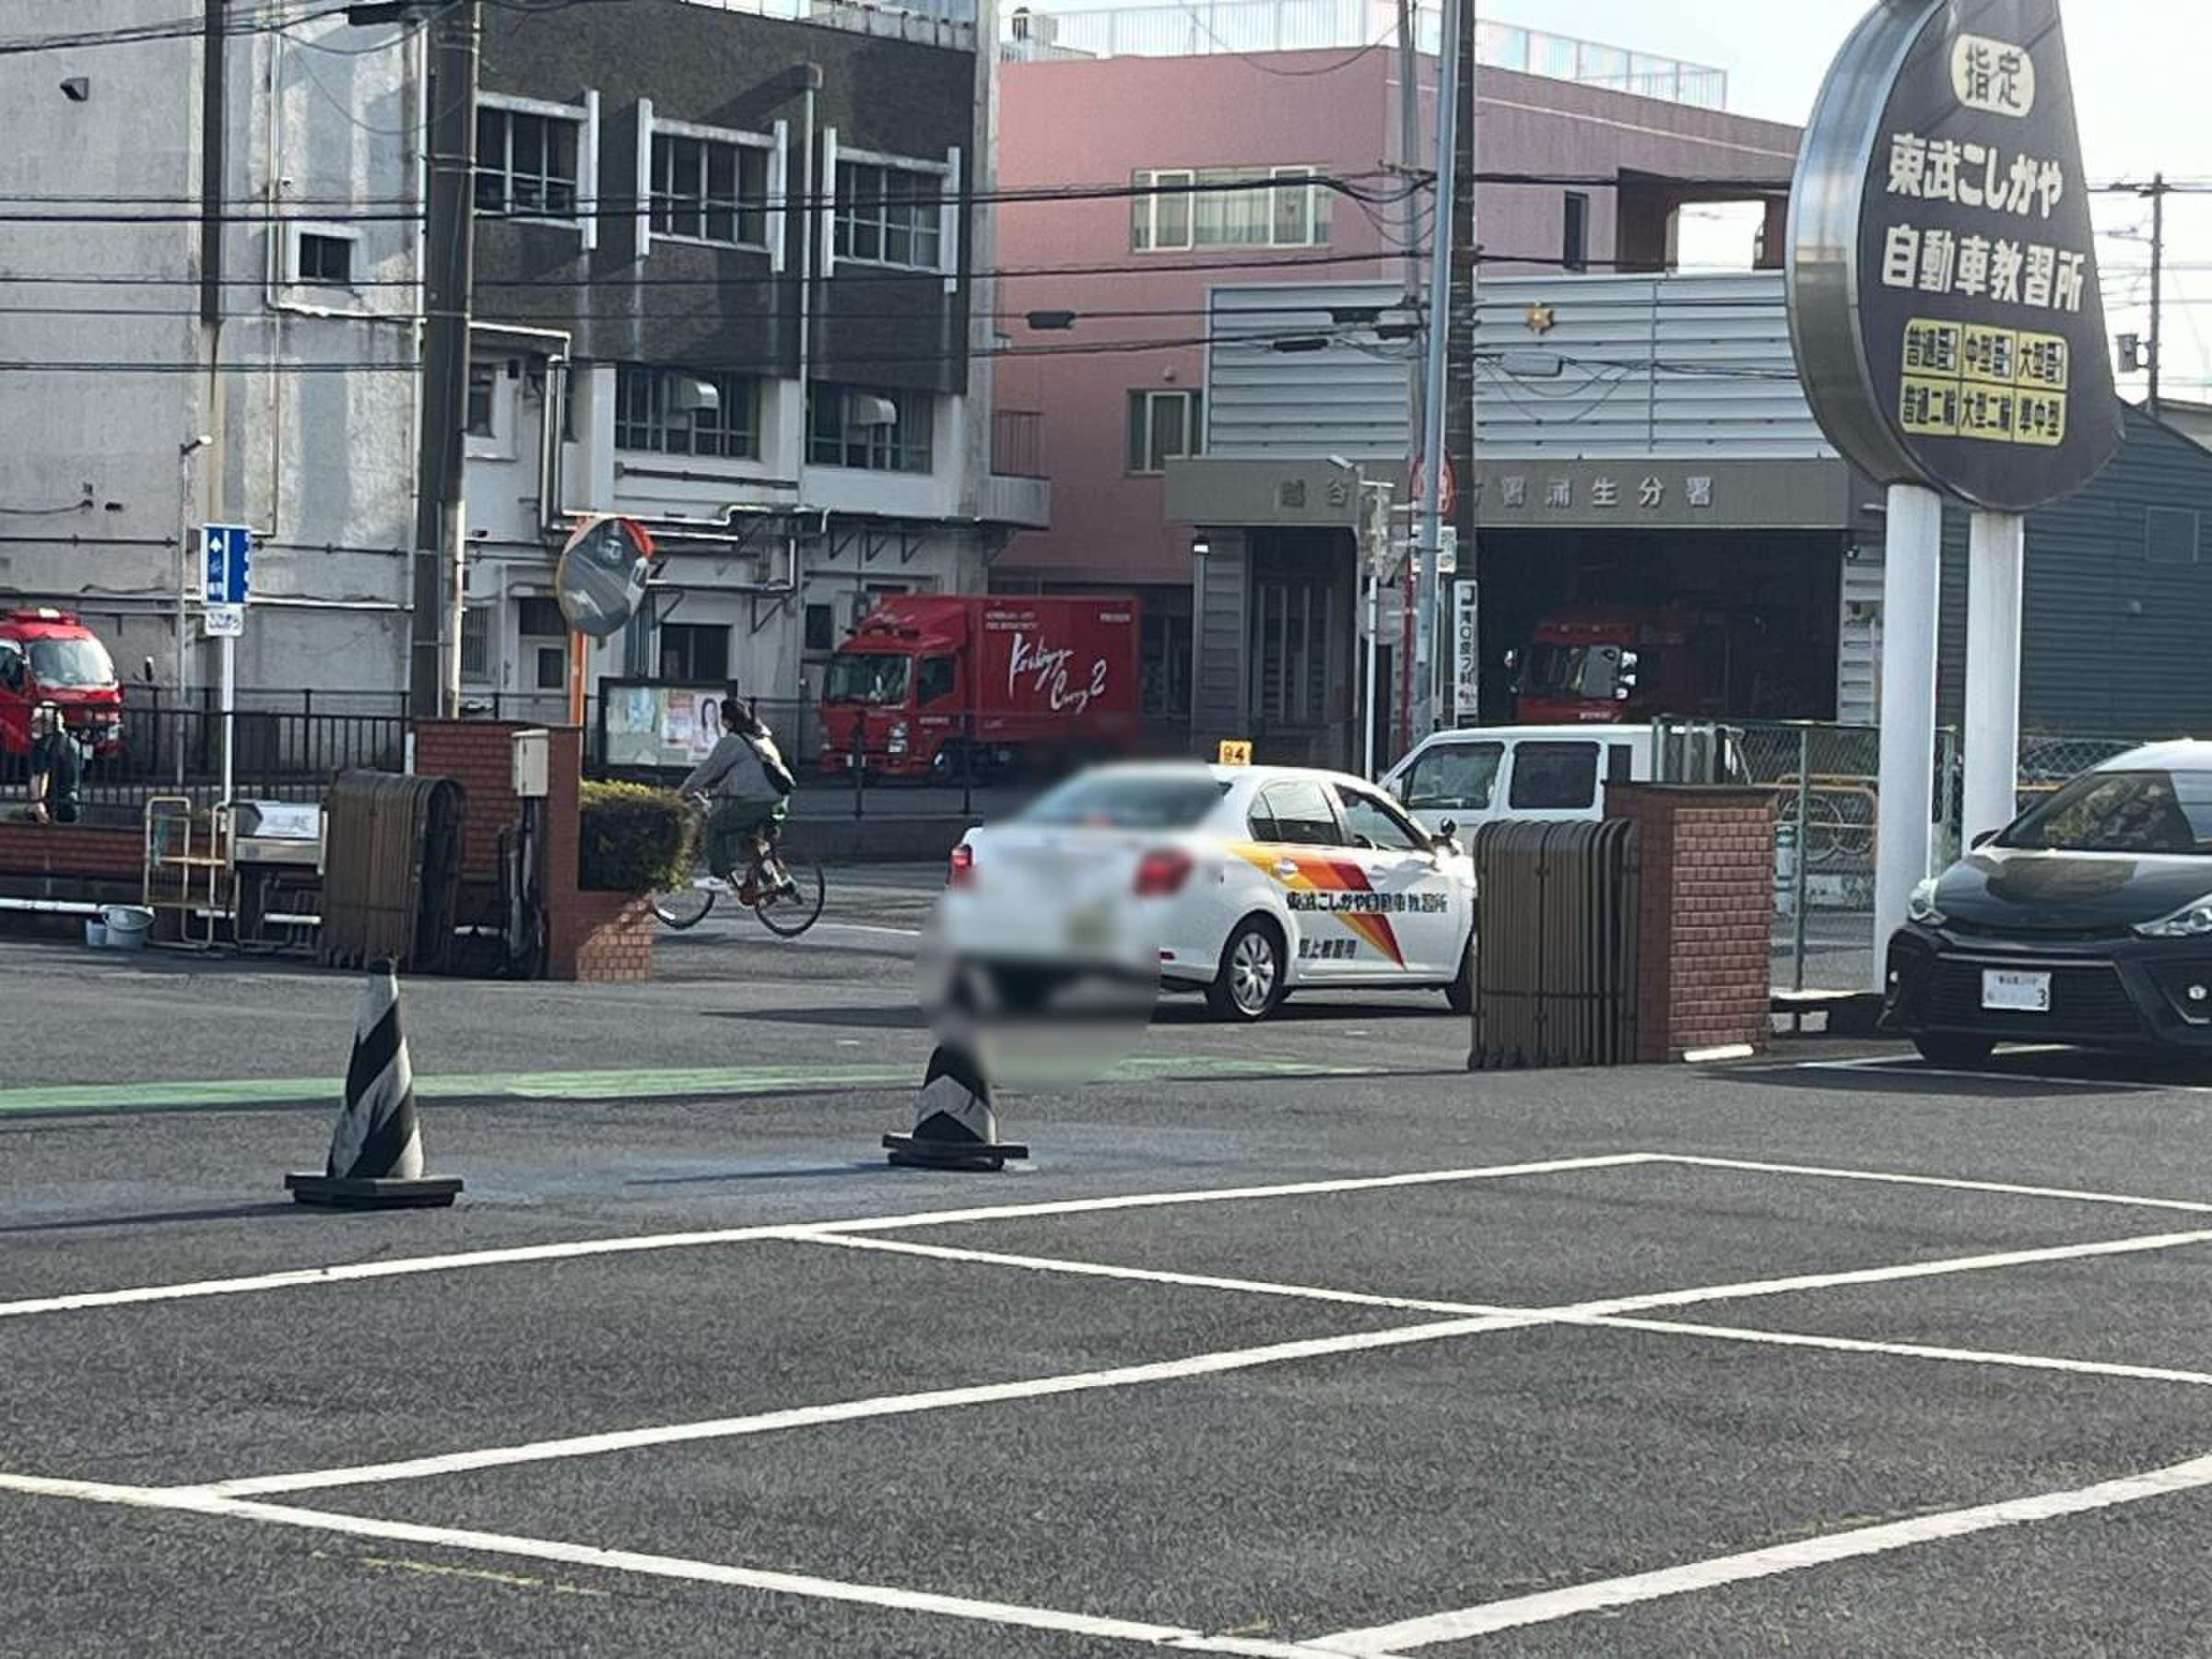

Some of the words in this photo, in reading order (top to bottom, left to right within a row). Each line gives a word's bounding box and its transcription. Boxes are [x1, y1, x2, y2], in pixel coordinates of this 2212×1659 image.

[1964, 42, 2021, 108] 指定
[1886, 133, 2064, 219] 東武こしがや
[1882, 224, 2086, 313] 自動車教習所
